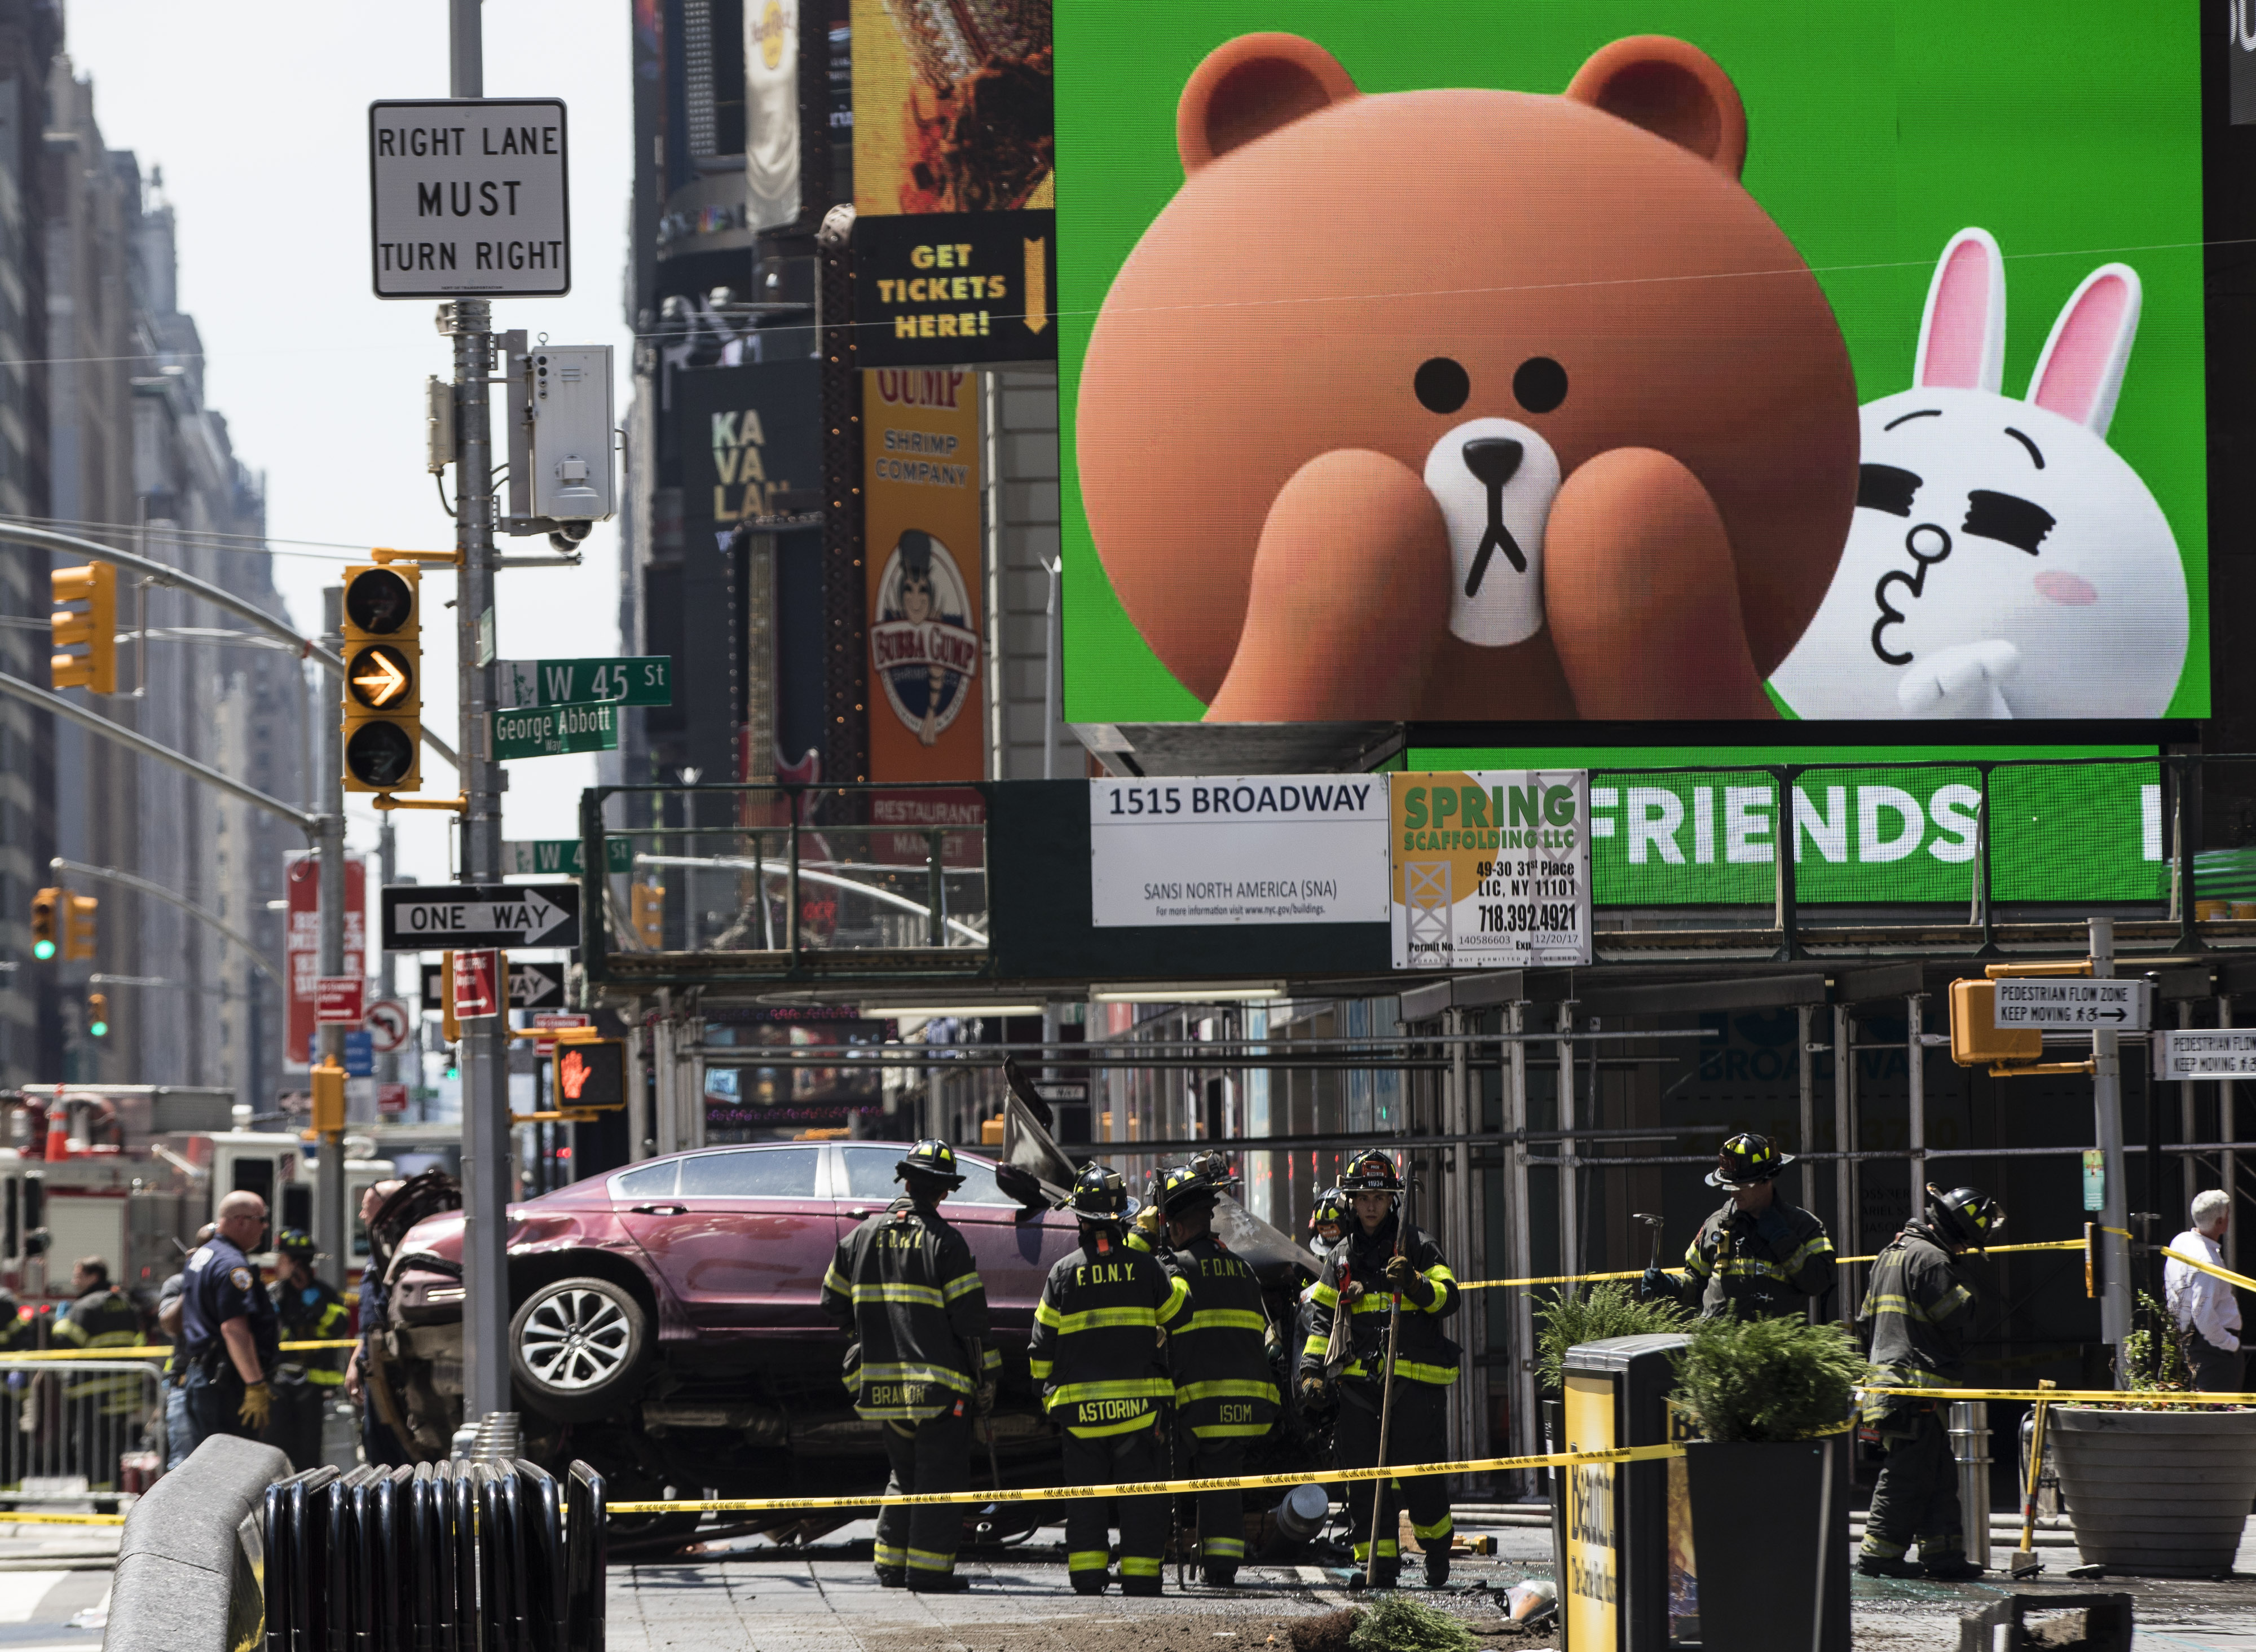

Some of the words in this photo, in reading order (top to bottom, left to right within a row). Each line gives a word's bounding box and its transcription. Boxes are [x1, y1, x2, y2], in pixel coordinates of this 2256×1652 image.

[378, 127, 465, 156] RIGHT
[483, 126, 558, 155] LANE
[417, 180, 521, 217] MUST
[380, 242, 456, 271] TURN
[475, 240, 562, 270] RIGHT
[911, 244, 973, 270] GET
[876, 276, 1007, 303] TICKETS
[895, 311, 990, 338] HERE!
[884, 429, 958, 456] SHRIMP
[875, 457, 970, 487] COMPANY
[930, 625, 975, 669] GUMP
[545, 666, 574, 701] W
[592, 665, 629, 700] 45
[644, 664, 664, 686] St
[496, 715, 552, 744] George
[558, 706, 611, 734] Abbott
[545, 739, 561, 754] Way
[1109, 788, 1181, 814] 1515
[1192, 784, 1370, 813] BROADWAY
[1404, 785, 1576, 829] SPRING
[874, 800, 982, 825] RESTAURANT
[1591, 783, 1981, 865] FRIENDS
[893, 833, 963, 857] MARET
[1404, 830, 1538, 850] SCAFFOLDING
[1543, 829, 1575, 848] LLC
[538, 846, 563, 871] W
[611, 839, 628, 861] St
[1477, 861, 1512, 877] 49-30
[1517, 859, 1538, 876] 31st
[1540, 861, 1575, 875] Place
[1144, 882, 1183, 900] SANSI
[1186, 882, 1232, 899] NORTH
[1236, 880, 1298, 898] AMERICA
[1301, 879, 1337, 900] (SNA)
[1478, 880, 1505, 898] LIC,
[1512, 880, 1529, 896] NY
[1535, 879, 1575, 896] 11101
[410, 906, 466, 930] ONE
[492, 904, 550, 929] WAY
[1156, 906, 1167, 915] For
[1188, 905, 1227, 915] information
[1230, 905, 1243, 914] visit
[1478, 904, 1576, 932] 718.392.4921
[1408, 941, 1439, 952] Permit
[1442, 941, 1455, 952] No.
[1459, 935, 1511, 945] 140586603
[1515, 940, 1534, 951] Exp.
[1535, 933, 1578, 945] 12/20/17
[2001, 986, 2066, 1001] PEDESTRIAN
[2069, 986, 2098, 1002] FLOW
[2100, 987, 2129, 1002] ZONE
[2001, 1006, 2028, 1021] KEEP
[2030, 1006, 2072, 1021] MOVING
[2173, 1037, 2229, 1051] PEDESTRIAN
[2173, 1057, 2197, 1072] KEEP
[1078, 1398, 1148, 1423] ASTORINA
[1219, 1404, 1252, 1424] ISOM
